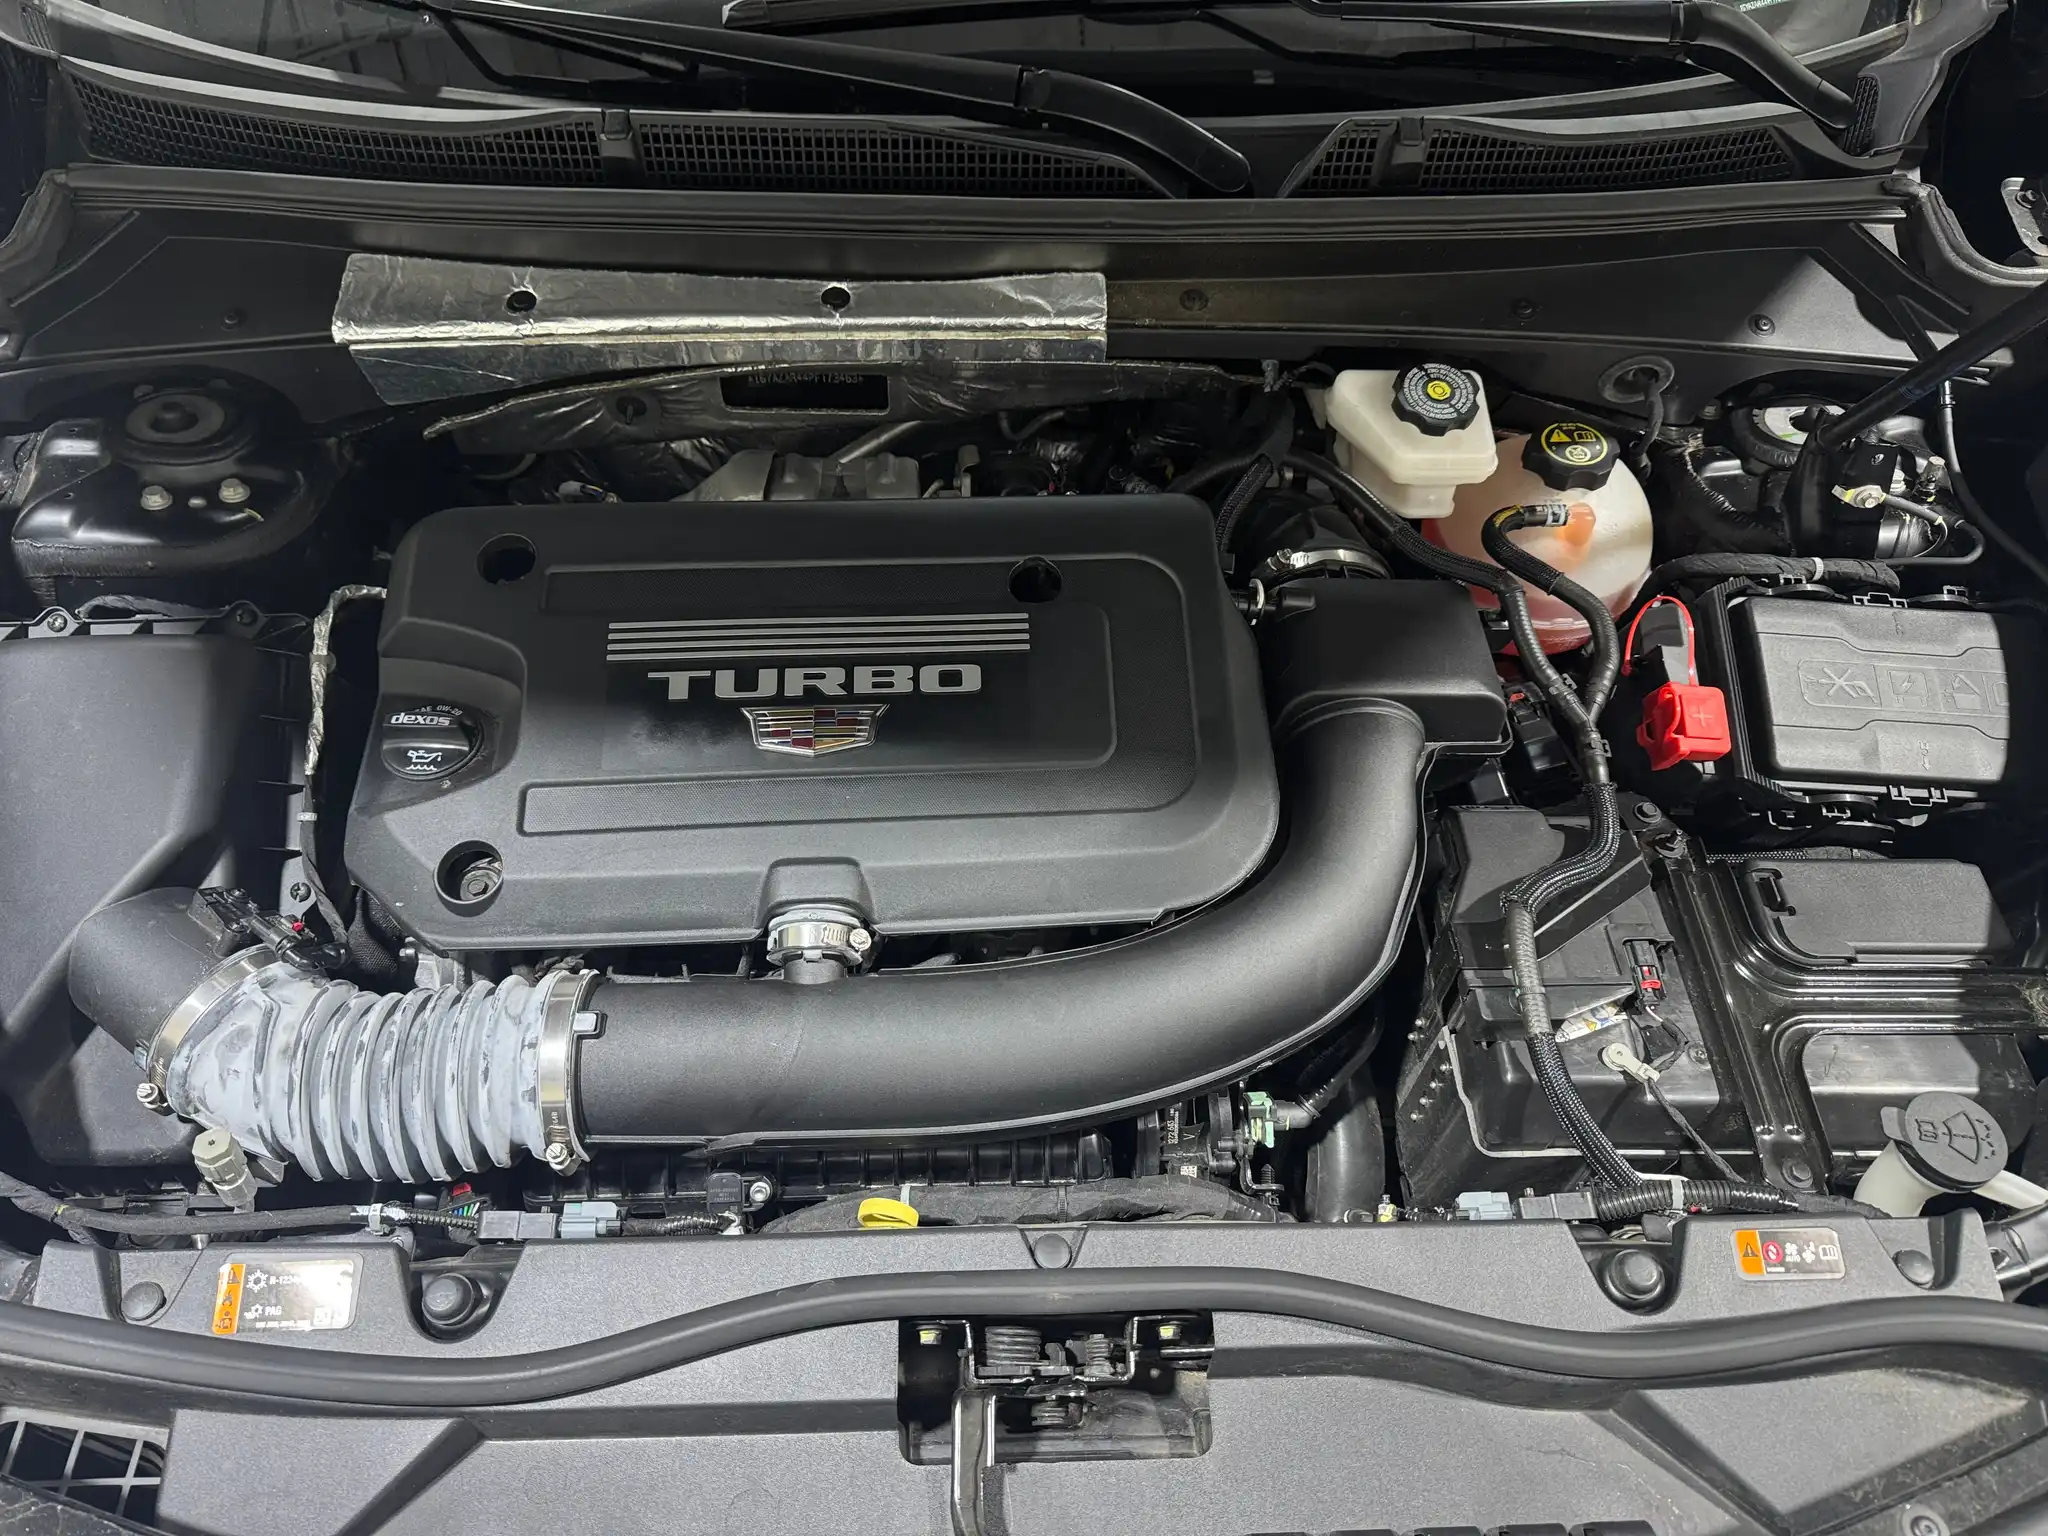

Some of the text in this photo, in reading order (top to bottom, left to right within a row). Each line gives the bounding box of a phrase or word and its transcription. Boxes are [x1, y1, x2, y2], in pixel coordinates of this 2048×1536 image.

[647, 664, 982, 701] TURBO
[390, 712, 454, 726] dexos
[265, 1305, 283, 1316] PAG
